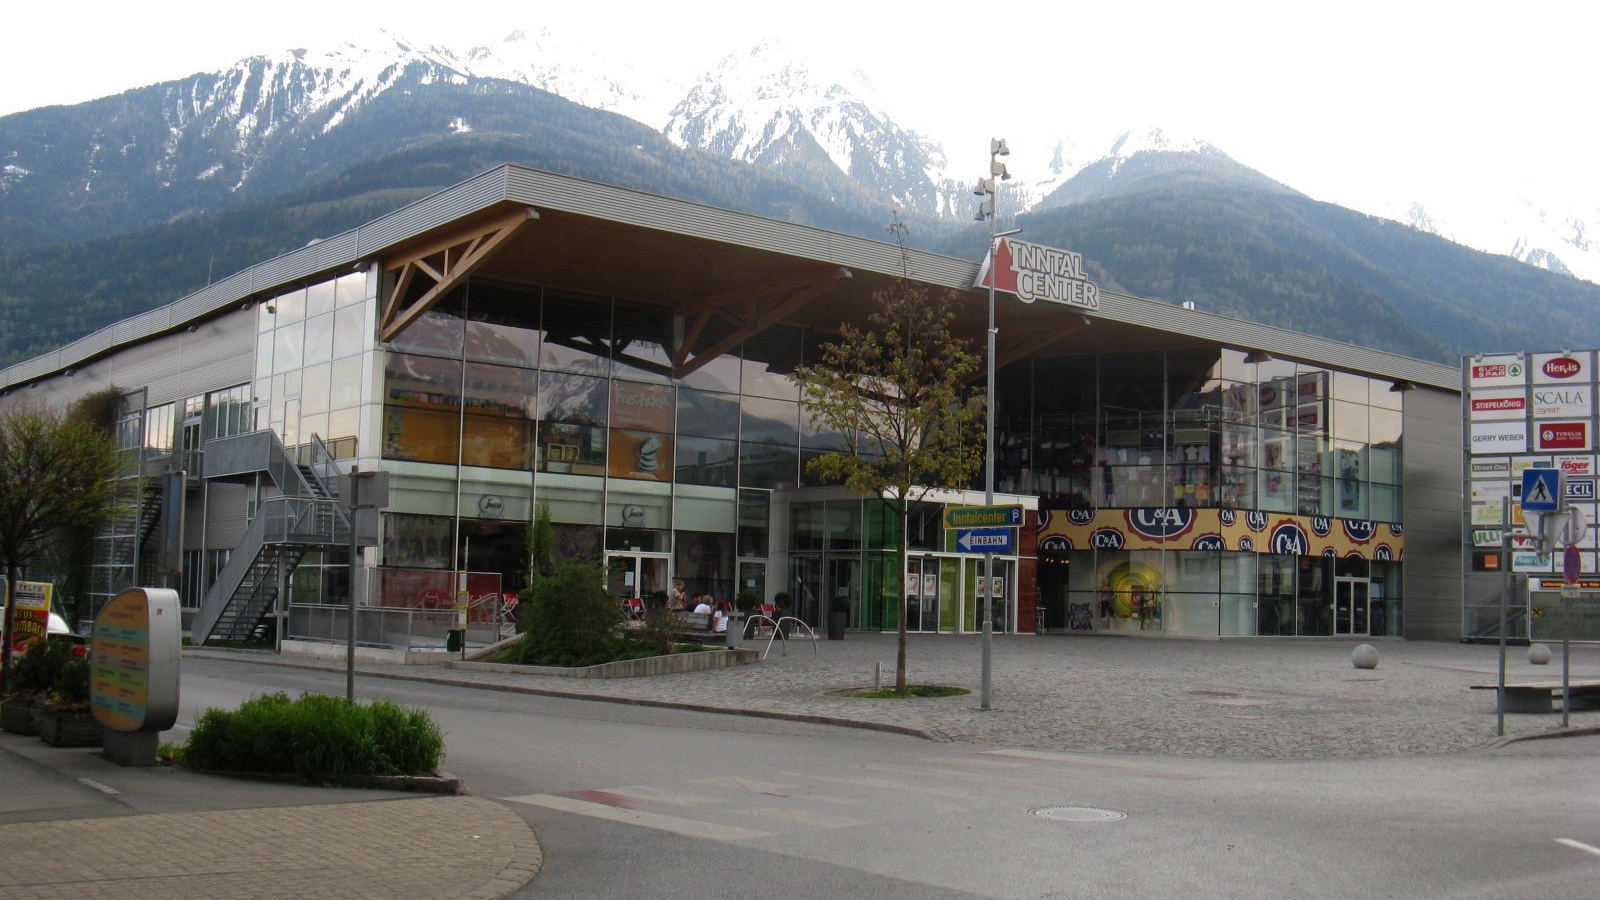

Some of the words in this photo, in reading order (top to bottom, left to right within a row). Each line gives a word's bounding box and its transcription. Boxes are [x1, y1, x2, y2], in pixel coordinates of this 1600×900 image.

[1009, 240, 1087, 280] INNTAL
[1016, 268, 1098, 308] CENTER
[1546, 363, 1578, 374] Hervis
[1534, 391, 1583, 404] SCALA
[1475, 400, 1521, 409] STIEFELKÖNIG
[1566, 485, 1592, 494] ECIL
[953, 511, 1007, 524] Inntalcenter
[1071, 509, 1090, 520] C&A
[1137, 508, 1185, 526] C&A
[1314, 517, 1329, 530] C&A
[970, 536, 1003, 545] EINBAHN
[1044, 541, 1067, 550] C&A
[1096, 534, 1120, 548] C&A
[1276, 533, 1303, 555] C&A
[19, 584, 42, 592] TELFS
